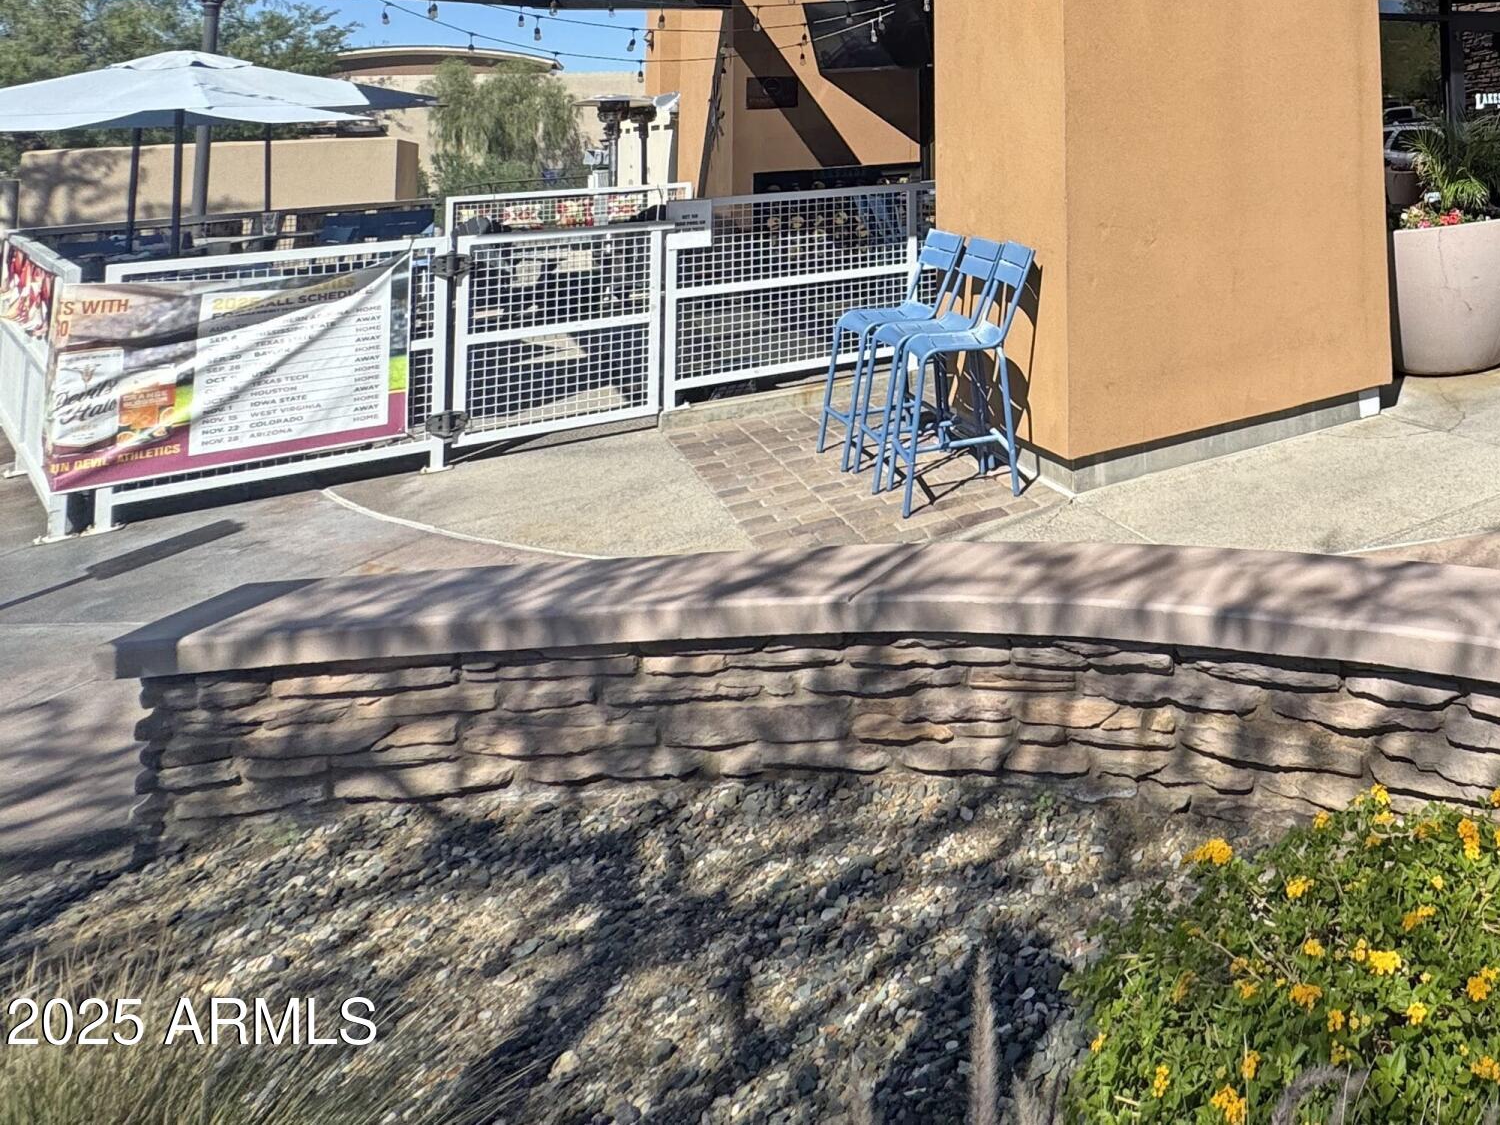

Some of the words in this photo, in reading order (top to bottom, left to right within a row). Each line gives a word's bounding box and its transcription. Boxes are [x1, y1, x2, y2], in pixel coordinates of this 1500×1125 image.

[82, 298, 130, 315] WITH
[355, 314, 382, 323] AWAY
[354, 334, 382, 343] AWAY
[354, 354, 381, 363] AWAY
[354, 364, 381, 373] HOME
[285, 374, 309, 382] TECH
[354, 374, 380, 383] HOME
[250, 386, 298, 397] HOUSTON
[353, 384, 380, 393] AWAY
[250, 397, 276, 407] IOWA
[279, 394, 308, 404] STATE
[353, 394, 380, 403] HOME
[250, 408, 278, 418] WEST
[280, 403, 322, 414] VIRGINIA
[353, 403, 380, 412] AWAY
[202, 416, 226, 425] NOV.
[249, 415, 304, 428] COLORADO
[352, 413, 380, 423] HOME
[201, 426, 225, 436] NOV.
[249, 427, 293, 439] ARIZONA
[201, 437, 225, 446] NOV.
[117, 444, 181, 462] ATHLETICS
